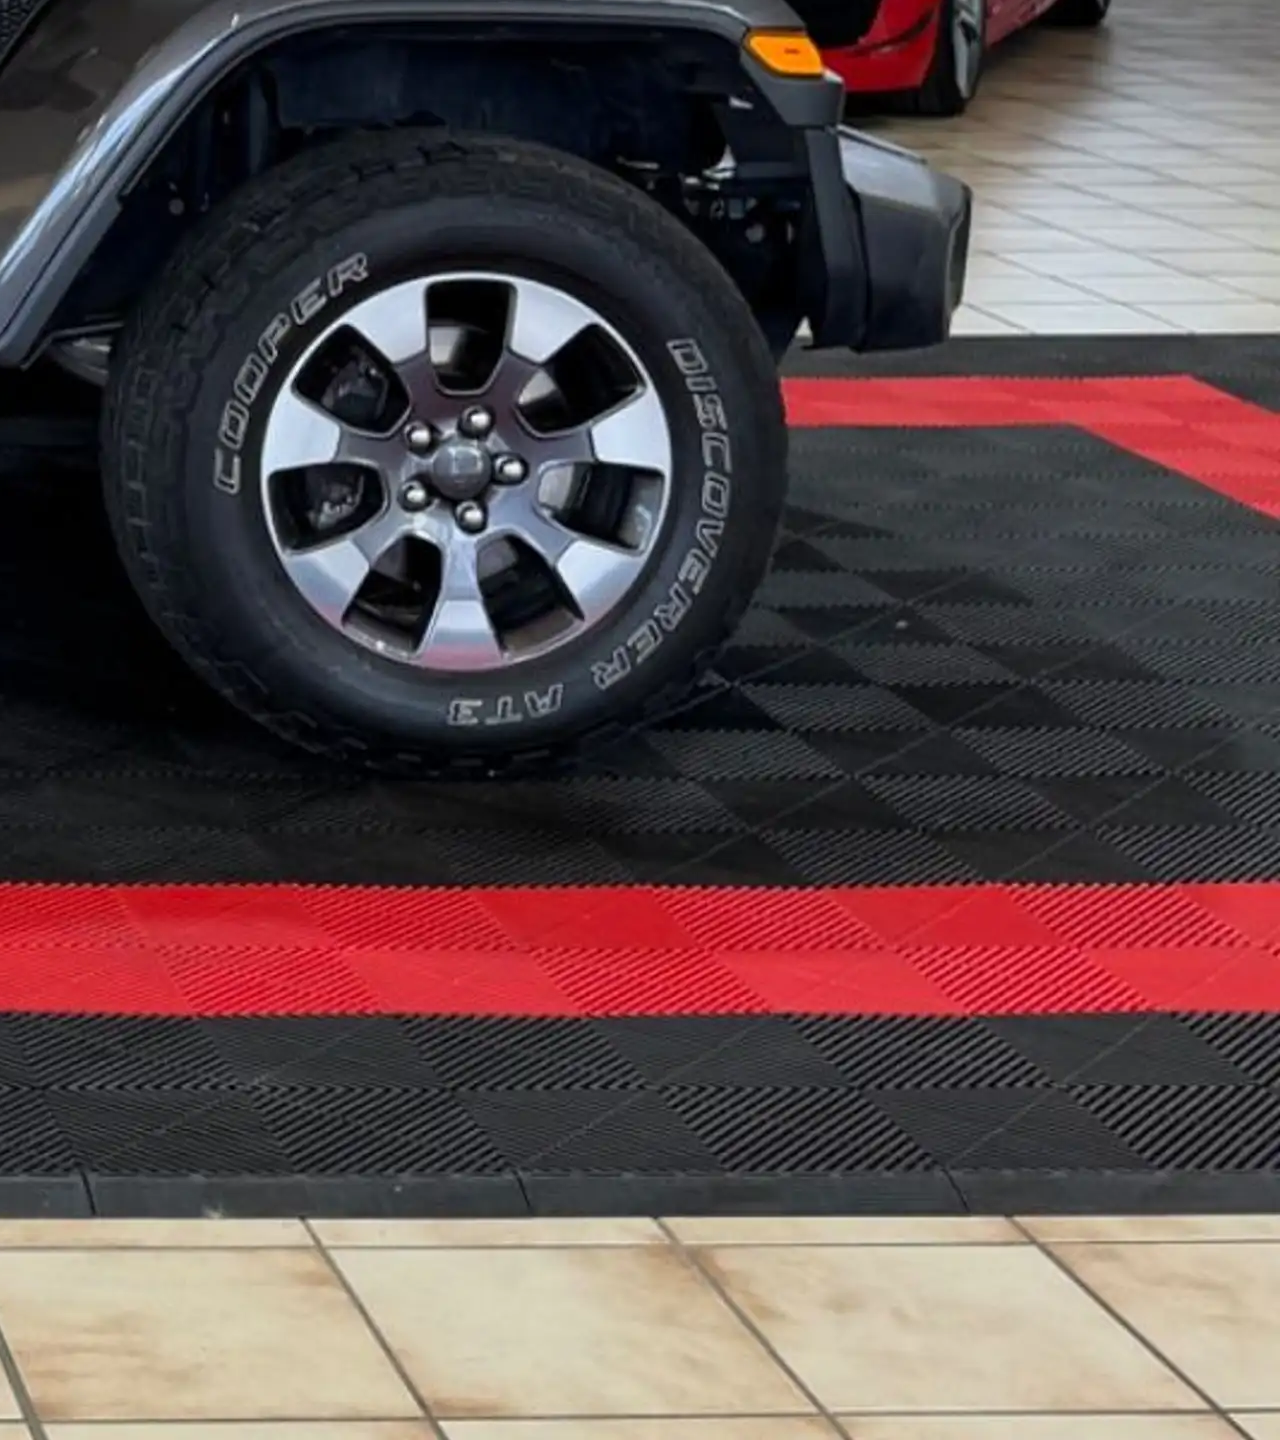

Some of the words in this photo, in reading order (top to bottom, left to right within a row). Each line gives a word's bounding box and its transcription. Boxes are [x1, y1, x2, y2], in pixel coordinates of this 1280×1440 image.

[213, 252, 369, 495] COOPER
[581, 338, 732, 690] DISCOVERER
[447, 684, 564, 725] AT3
